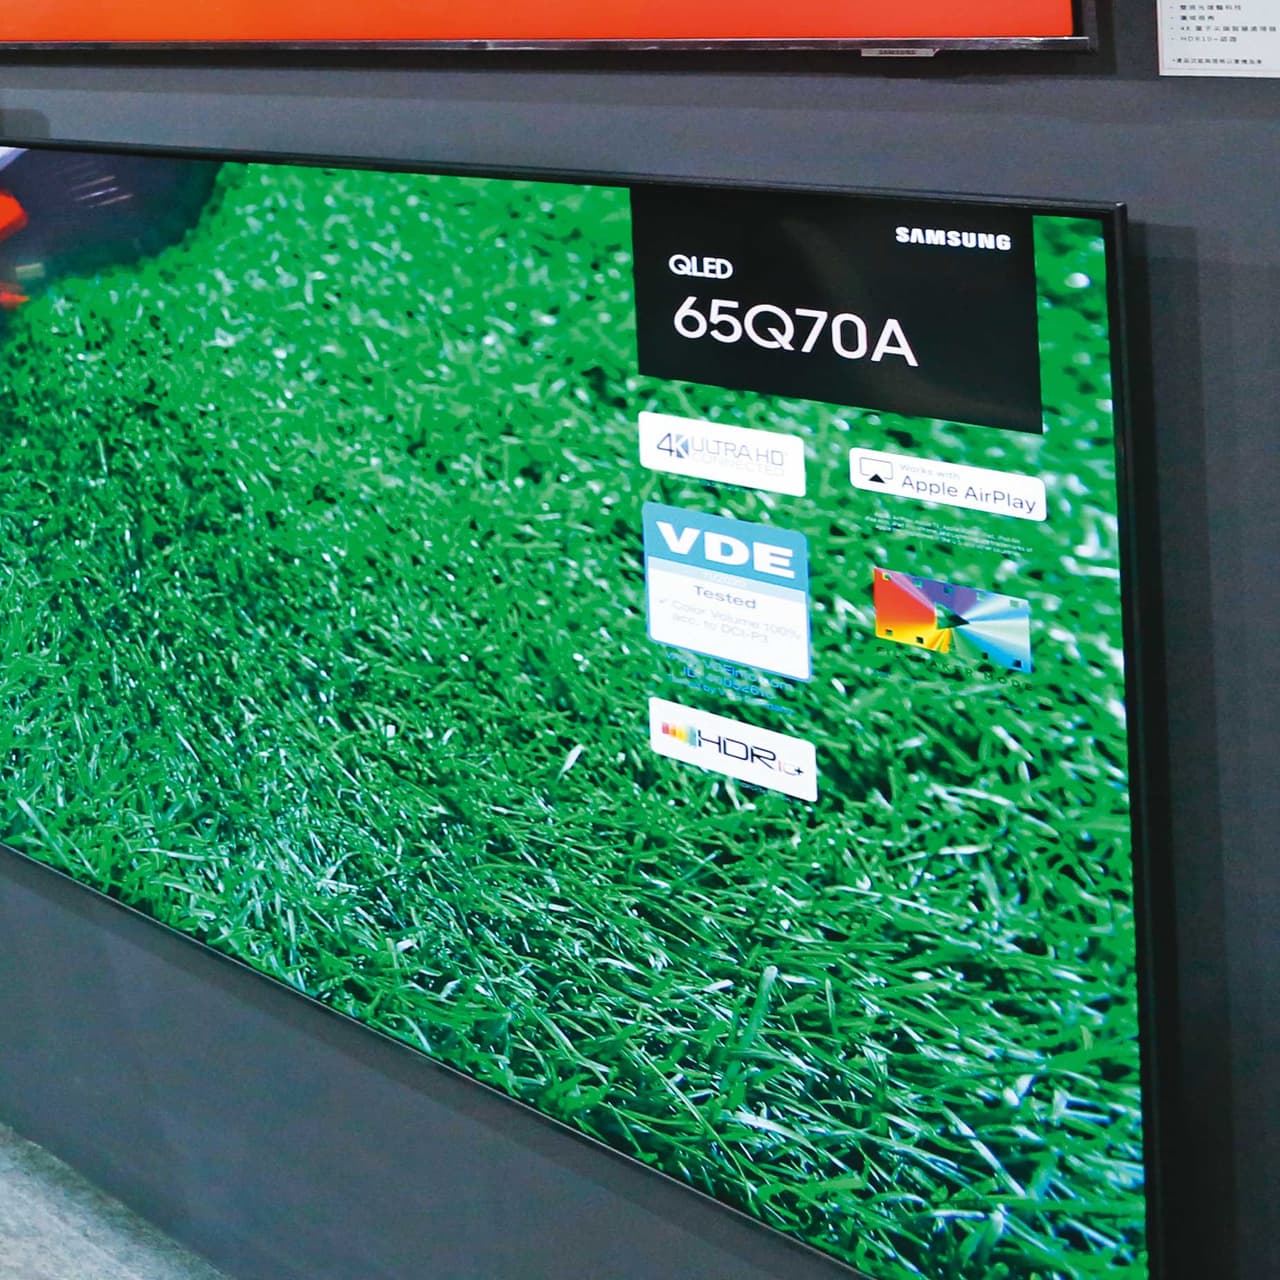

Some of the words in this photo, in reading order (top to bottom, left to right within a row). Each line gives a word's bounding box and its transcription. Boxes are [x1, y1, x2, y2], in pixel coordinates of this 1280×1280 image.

[895, 226, 1012, 251] SAMSUNG
[668, 253, 733, 280] QLED
[674, 295, 919, 367] 65Q70A
[657, 432, 689, 459] 4K
[691, 435, 751, 462] ULTRA
[752, 444, 784, 467] HD
[898, 462, 933, 476] Works
[936, 468, 960, 480] with
[902, 475, 958, 498] Apple
[965, 485, 1036, 514] AirPlay
[656, 521, 795, 578] VDE
[694, 585, 756, 610] Tested
[672, 600, 706, 616] Color
[711, 609, 760, 630] Volume
[764, 622, 802, 640] 100%
[698, 729, 804, 776] HDR10+
